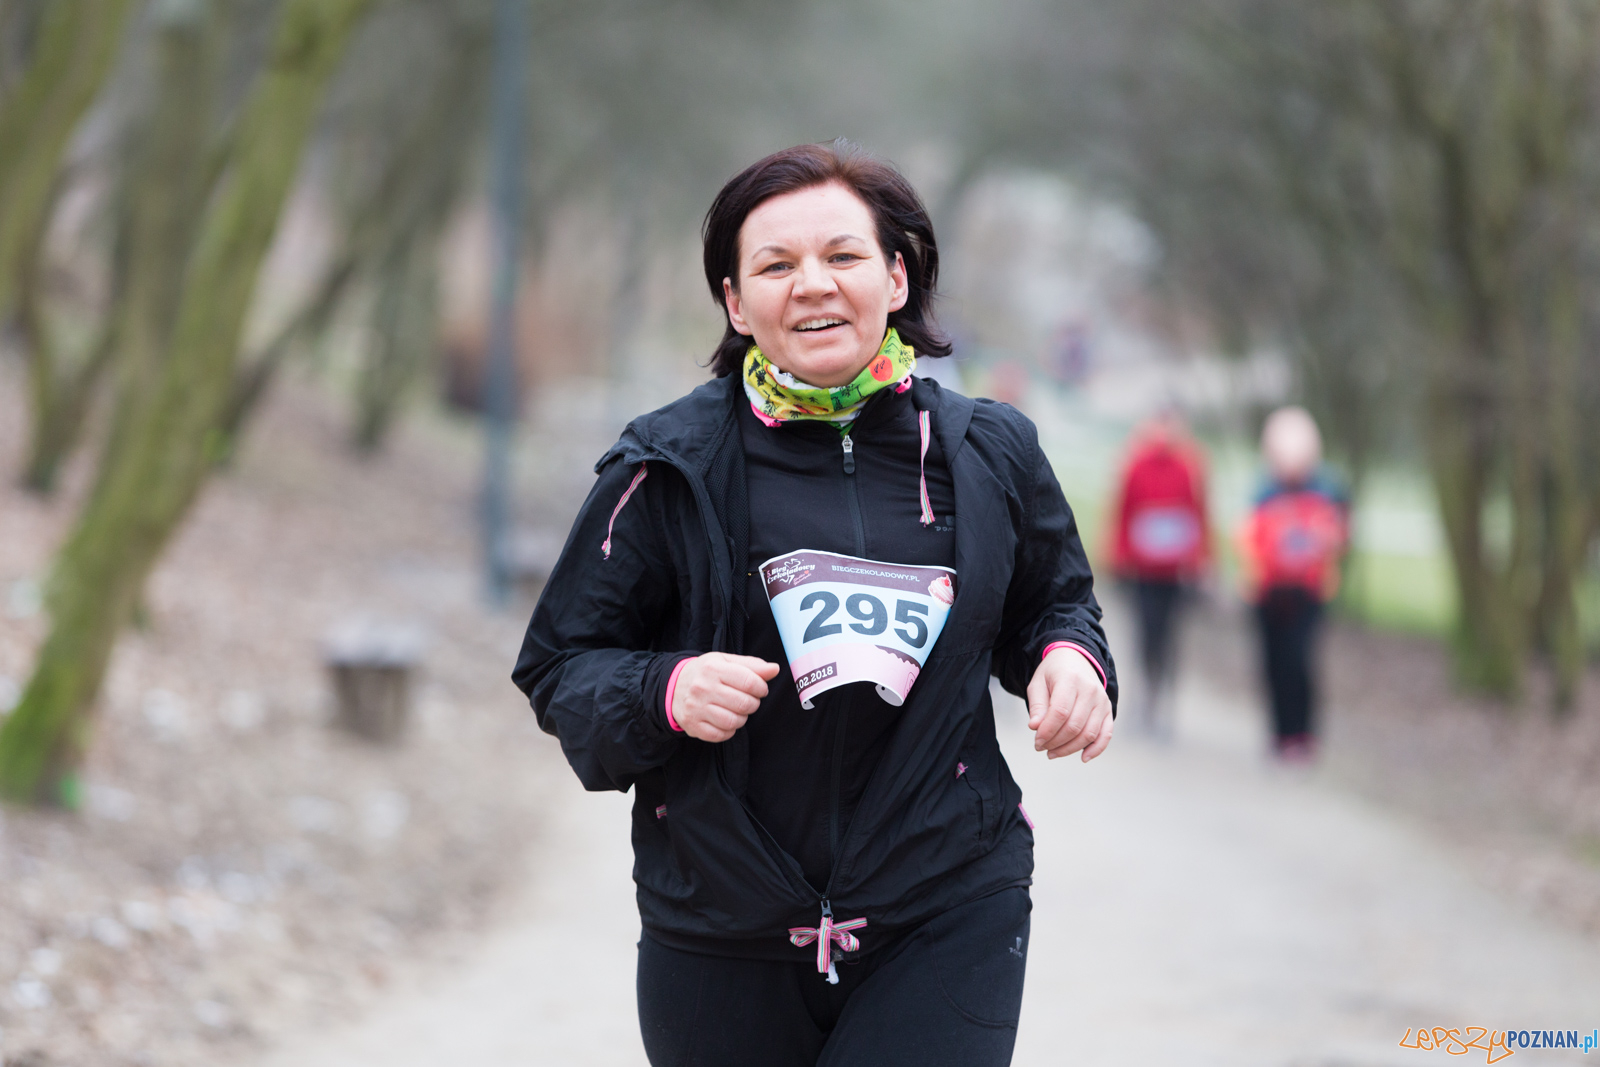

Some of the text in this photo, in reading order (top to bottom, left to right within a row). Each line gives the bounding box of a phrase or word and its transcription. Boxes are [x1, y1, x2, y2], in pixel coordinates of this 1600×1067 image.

[831, 565, 920, 582] BIEGCZEKOLADOWY.PL
[800, 590, 929, 649] 295
[796, 666, 834, 693] .02.2018
